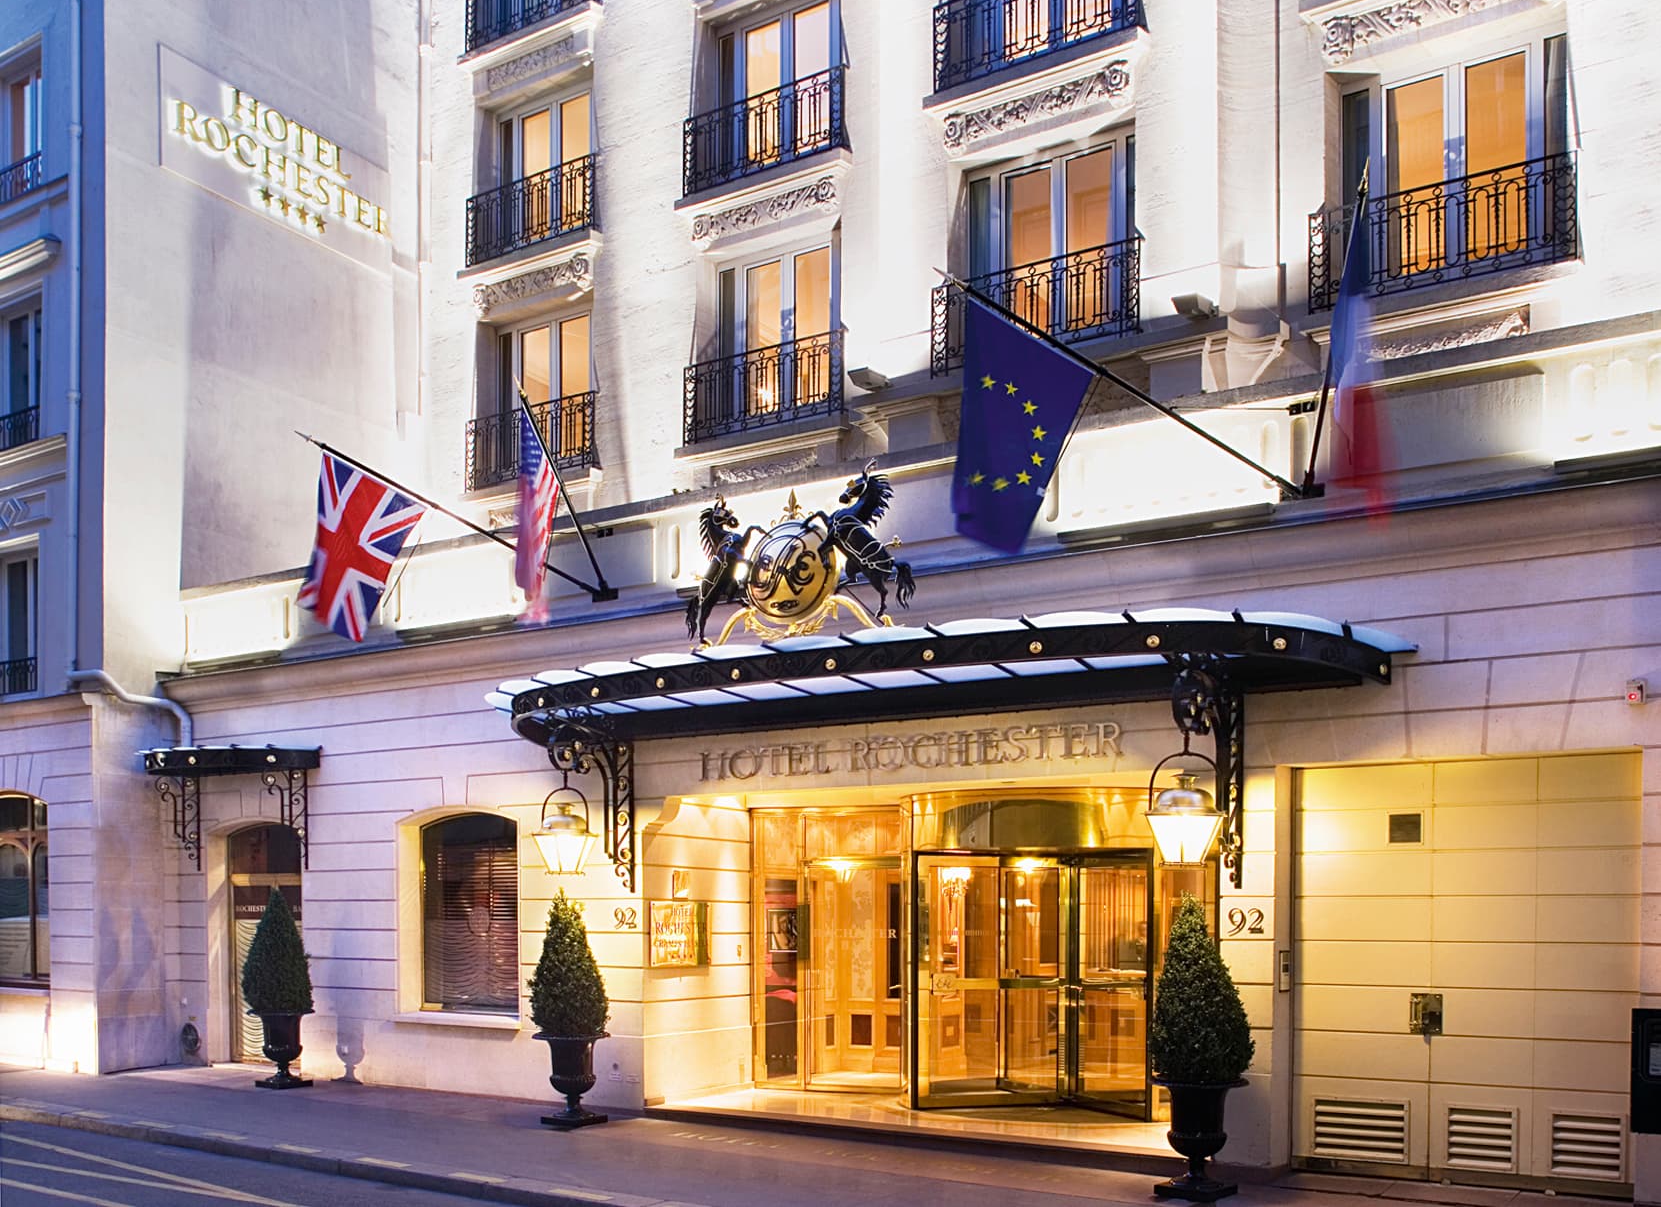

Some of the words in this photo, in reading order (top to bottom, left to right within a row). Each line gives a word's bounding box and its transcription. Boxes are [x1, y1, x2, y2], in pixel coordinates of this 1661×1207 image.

[228, 85, 352, 180] HOTEL
[171, 98, 392, 236] ROCHESTER
[699, 743, 832, 782] HOTEL
[848, 721, 1125, 772] ROCHESTER
[614, 907, 637, 929] 92
[1228, 907, 1265, 937] 92
